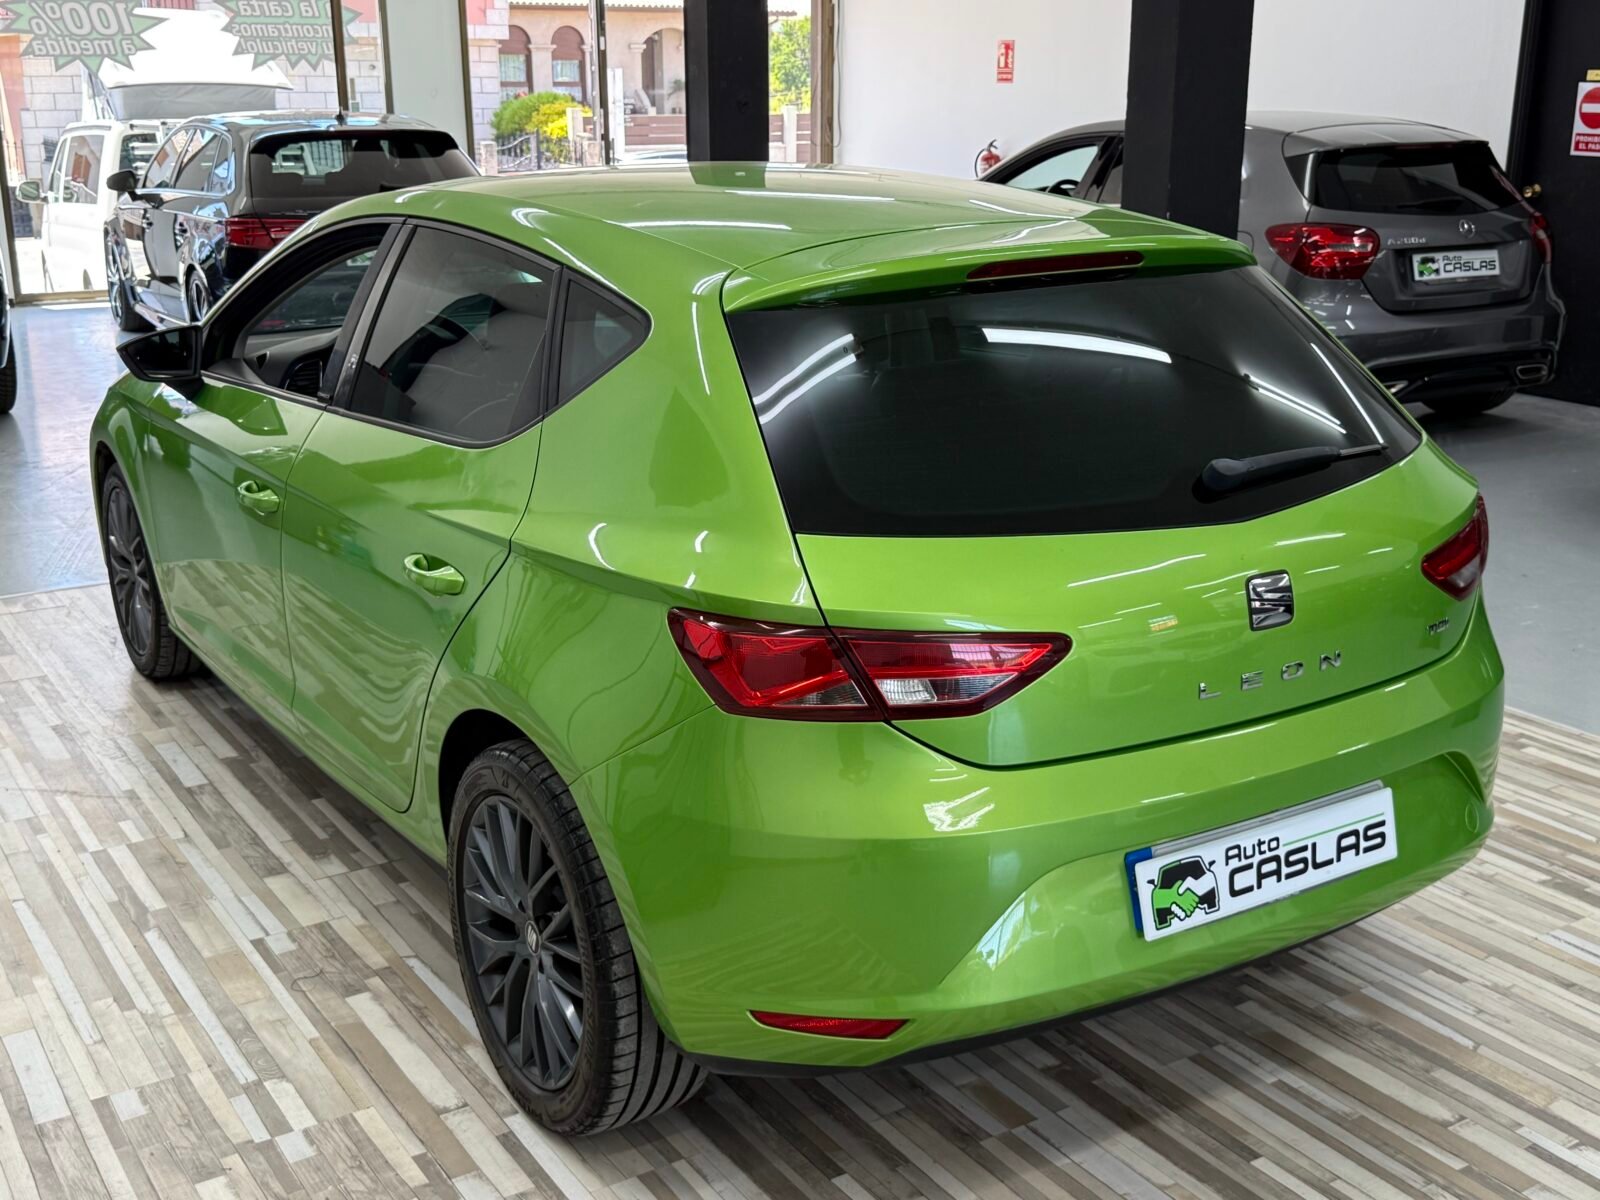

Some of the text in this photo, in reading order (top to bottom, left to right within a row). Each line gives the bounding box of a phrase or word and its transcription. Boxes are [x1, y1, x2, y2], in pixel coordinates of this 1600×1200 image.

[1443, 260, 1497, 273] CASLAS
[1199, 650, 1342, 700] LEON
[1225, 836, 1280, 866] Auto
[1228, 819, 1386, 898] CASLAS
